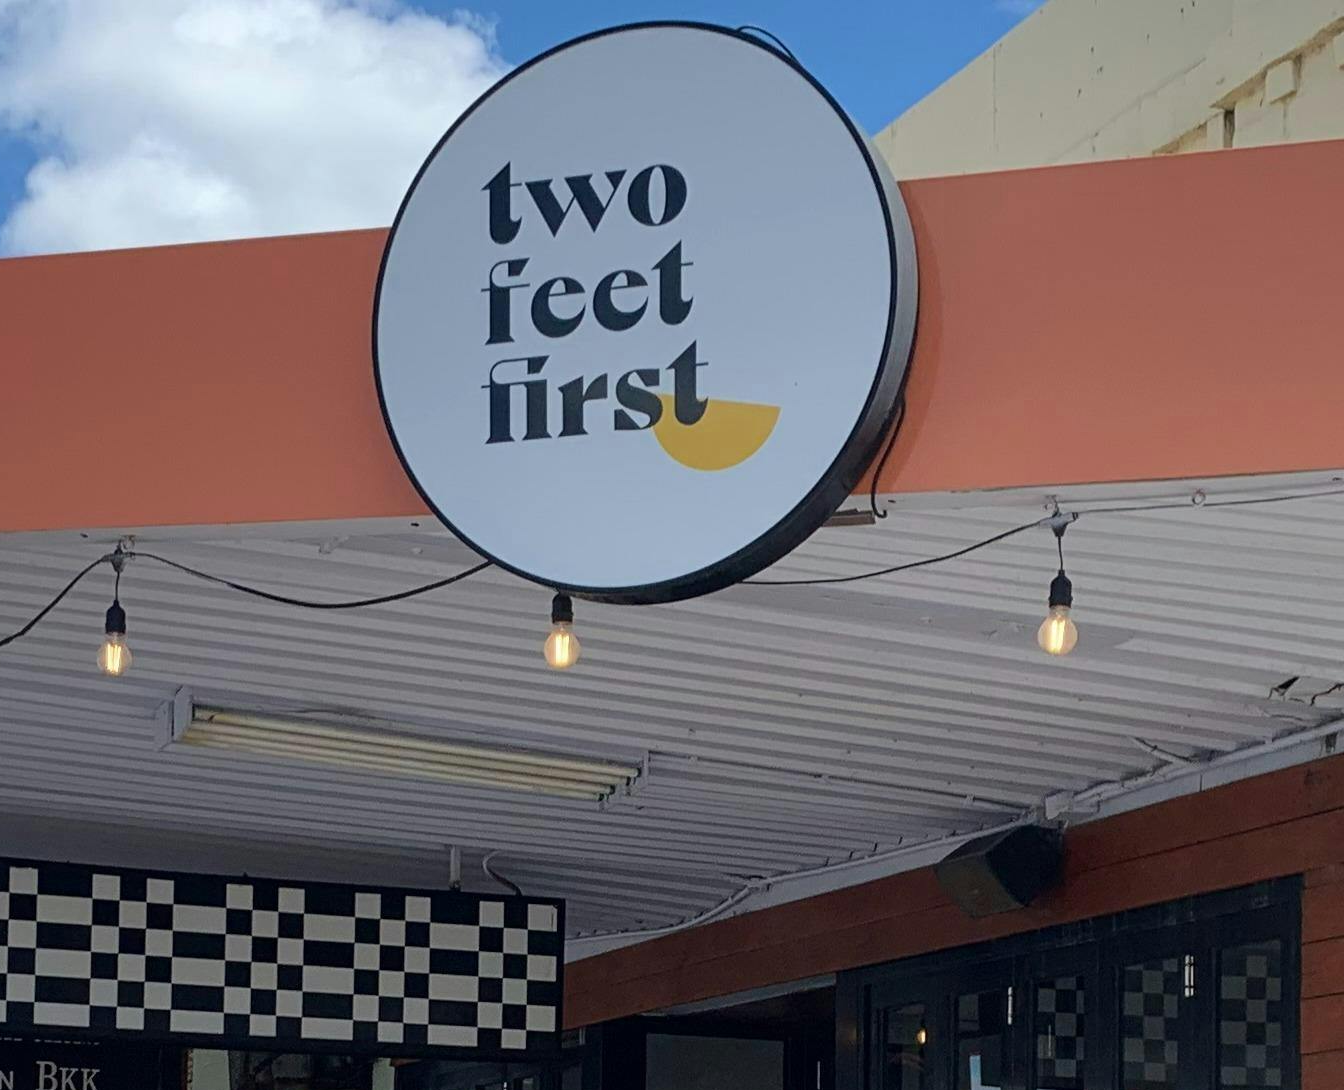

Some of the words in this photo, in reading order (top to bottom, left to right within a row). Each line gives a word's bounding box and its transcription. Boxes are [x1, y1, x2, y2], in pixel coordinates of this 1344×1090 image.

[481, 160, 688, 245] two
[481, 240, 694, 345] feet
[481, 340, 709, 444] first
